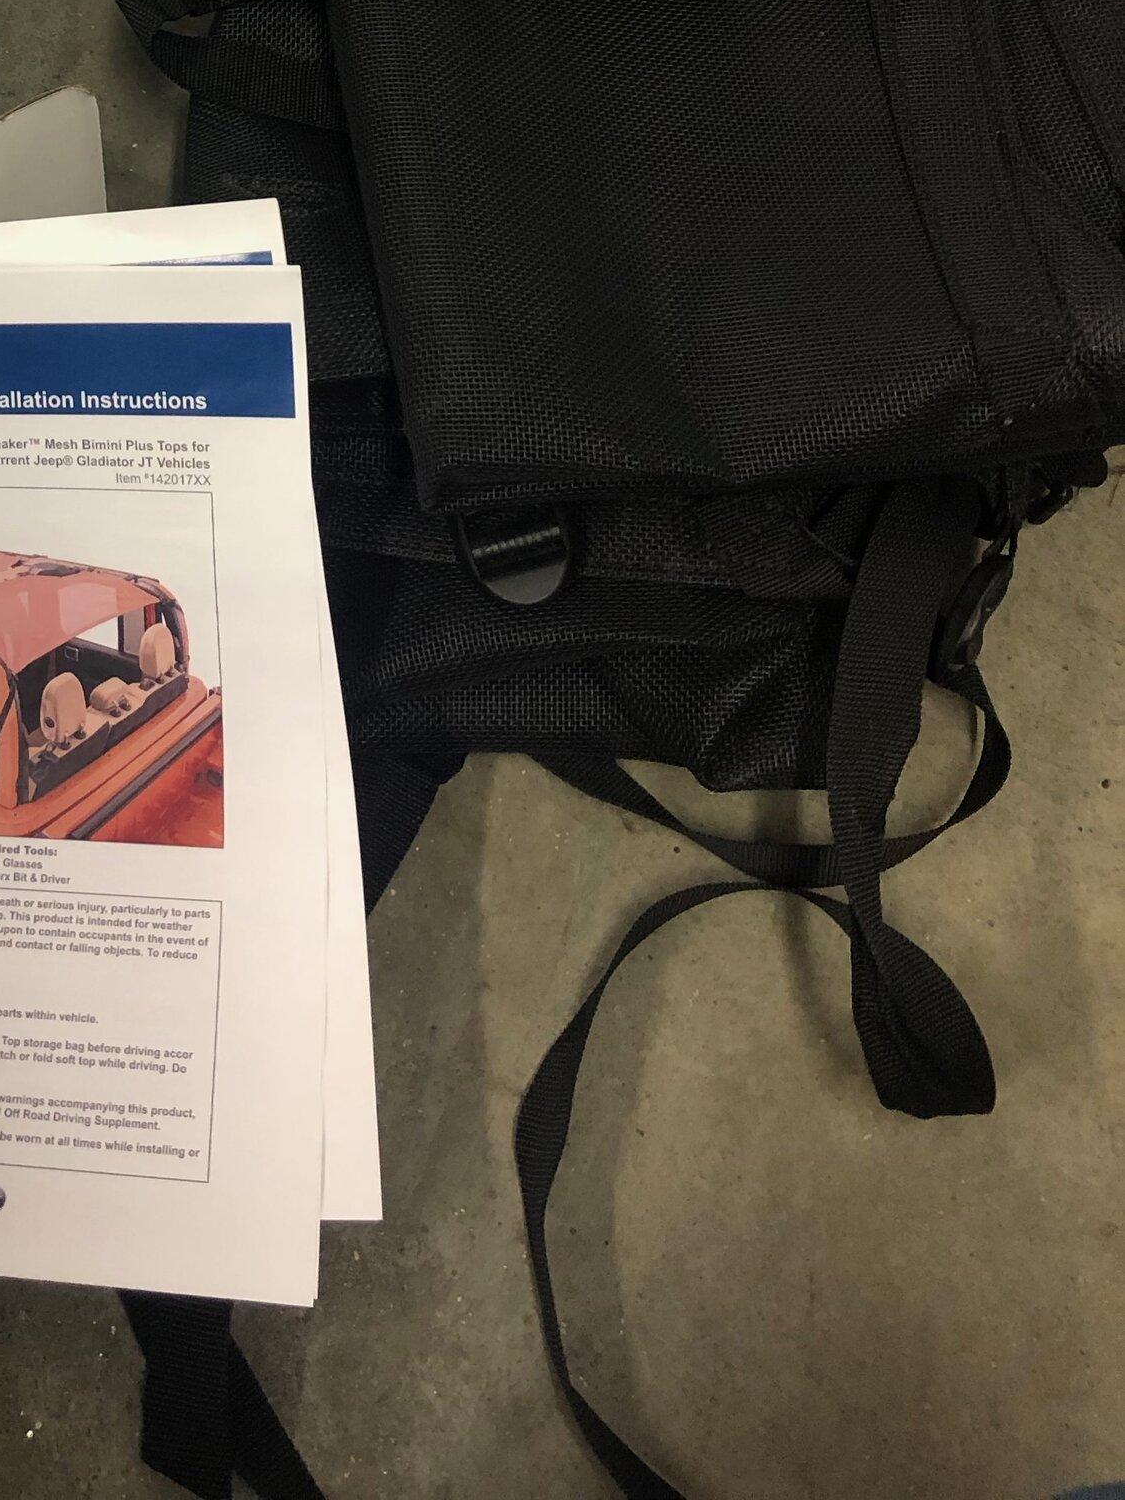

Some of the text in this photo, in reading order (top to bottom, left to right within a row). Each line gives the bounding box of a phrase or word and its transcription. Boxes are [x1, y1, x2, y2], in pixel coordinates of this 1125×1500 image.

[80, 390, 208, 411] Instructions
[44, 439, 79, 450] Mesh
[81, 440, 122, 450] Bimini
[125, 440, 154, 451] Plus
[159, 441, 188, 454] Tops
[191, 442, 209, 452] for
[75, 456, 135, 467] Gladiator
[137, 457, 152, 468] JT
[157, 458, 211, 469] Vehicles
[115, 472, 142, 483] Item
[23, 846, 58, 856] Tools:
[1, 858, 43, 869] Glasses
[12, 872, 28, 881] Bit
[29, 873, 38, 882] &
[39, 874, 70, 884] Driver
[36, 900, 75, 911] serious
[109, 904, 169, 918] particularly
[170, 907, 182, 916] to
[183, 908, 211, 920] parts
[9, 911, 31, 921] This
[32, 913, 74, 926] product
[74, 915, 85, 924] is
[87, 916, 133, 927] intended
[133, 919, 150, 928] for
[151, 920, 193, 931] weather
[24, 1010, 57, 1020] within
[58, 1012, 99, 1023] vehicle.
[3, 1108, 21, 1118] Off
[22, 1110, 51, 1121] Road
[52, 1112, 92, 1127] Driving
[93, 1116, 162, 1132] Supplement.
[14, 1134, 42, 1144] worn
[43, 1136, 55, 1145] at
[57, 1137, 71, 1146] all
[72, 1138, 102, 1149] times
[104, 1141, 134, 1152] while
[135, 1143, 186, 1158] installing
[187, 1149, 200, 1157] or
